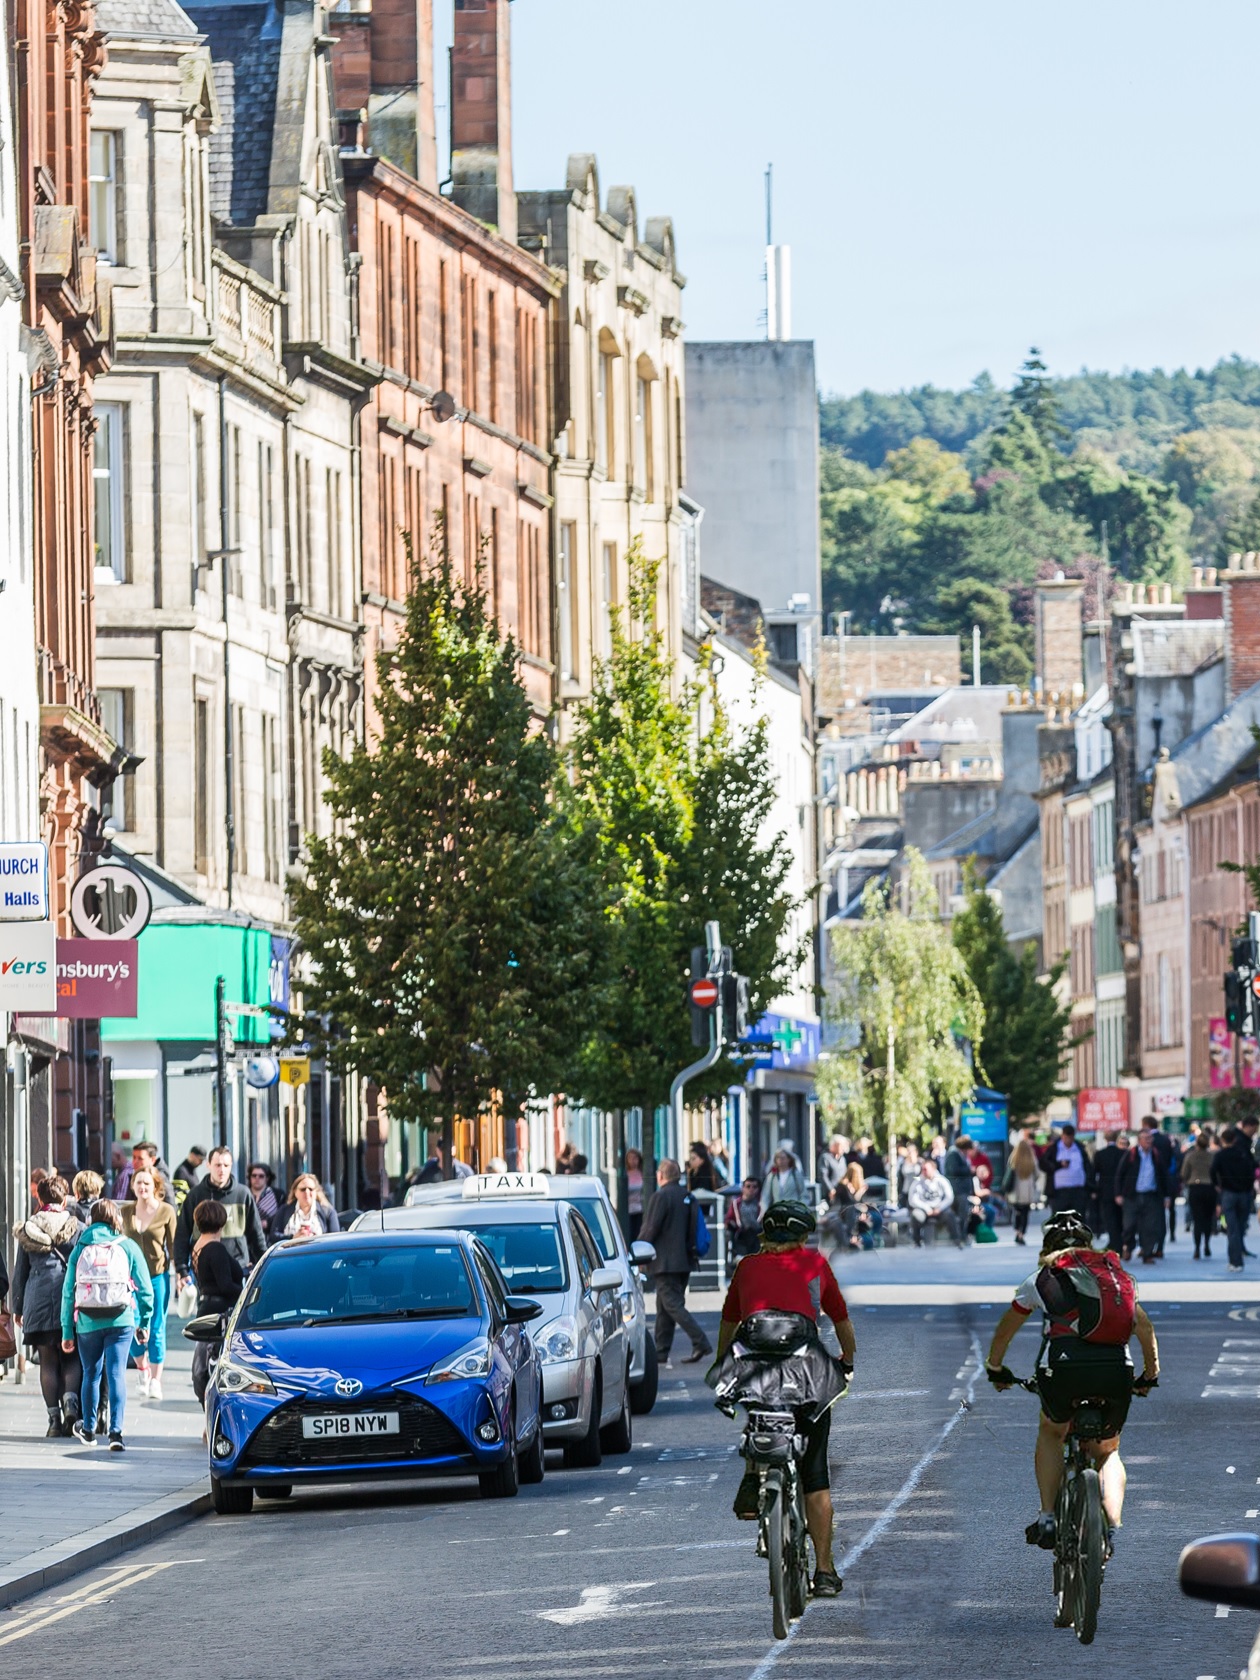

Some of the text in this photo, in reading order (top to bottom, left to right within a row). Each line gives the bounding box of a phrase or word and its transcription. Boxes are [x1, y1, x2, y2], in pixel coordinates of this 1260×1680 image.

[0, 858, 38, 875] URCH
[5, 892, 40, 906] Halls
[478, 1176, 533, 1189] TAXI
[313, 1415, 388, 1435] SP18 NYW
